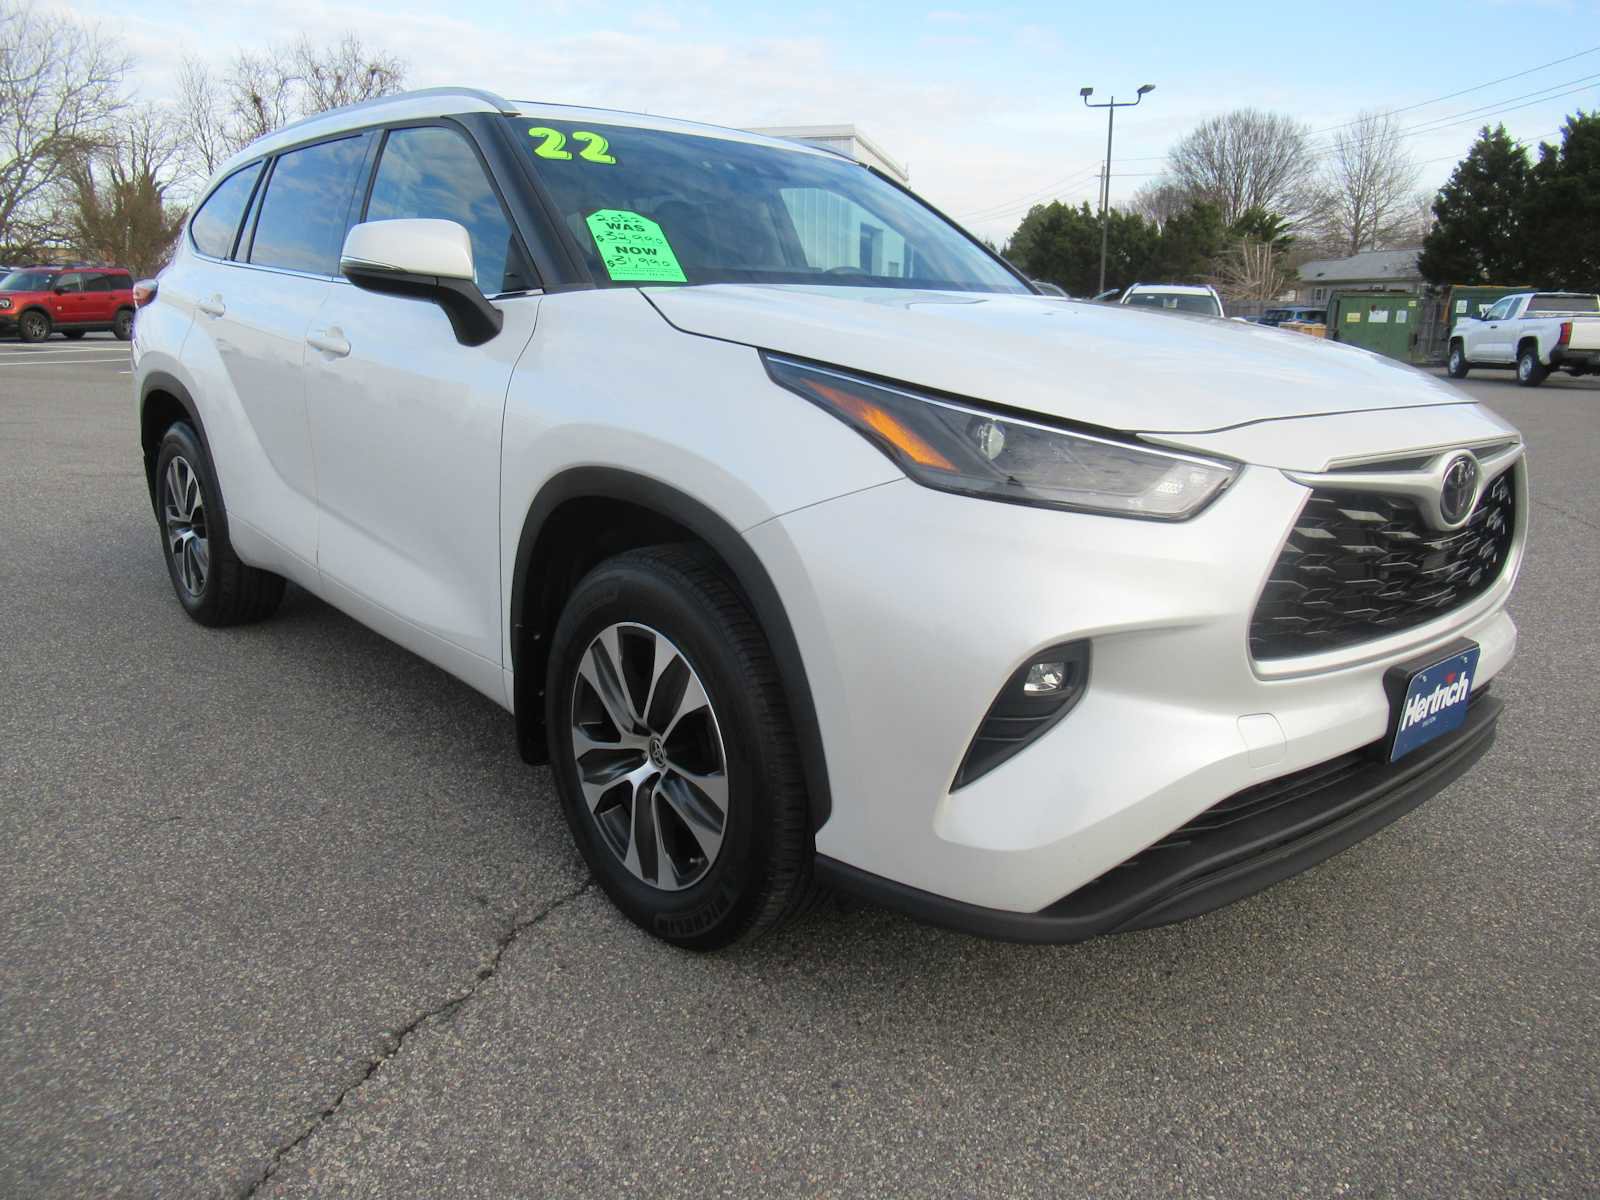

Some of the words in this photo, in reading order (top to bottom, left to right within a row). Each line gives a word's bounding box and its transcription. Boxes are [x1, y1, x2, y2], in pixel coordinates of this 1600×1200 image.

[528, 127, 617, 164] 22
[606, 222, 645, 232] WAS
[615, 246, 657, 256] NOW
[1401, 671, 1469, 732] Hertrich
